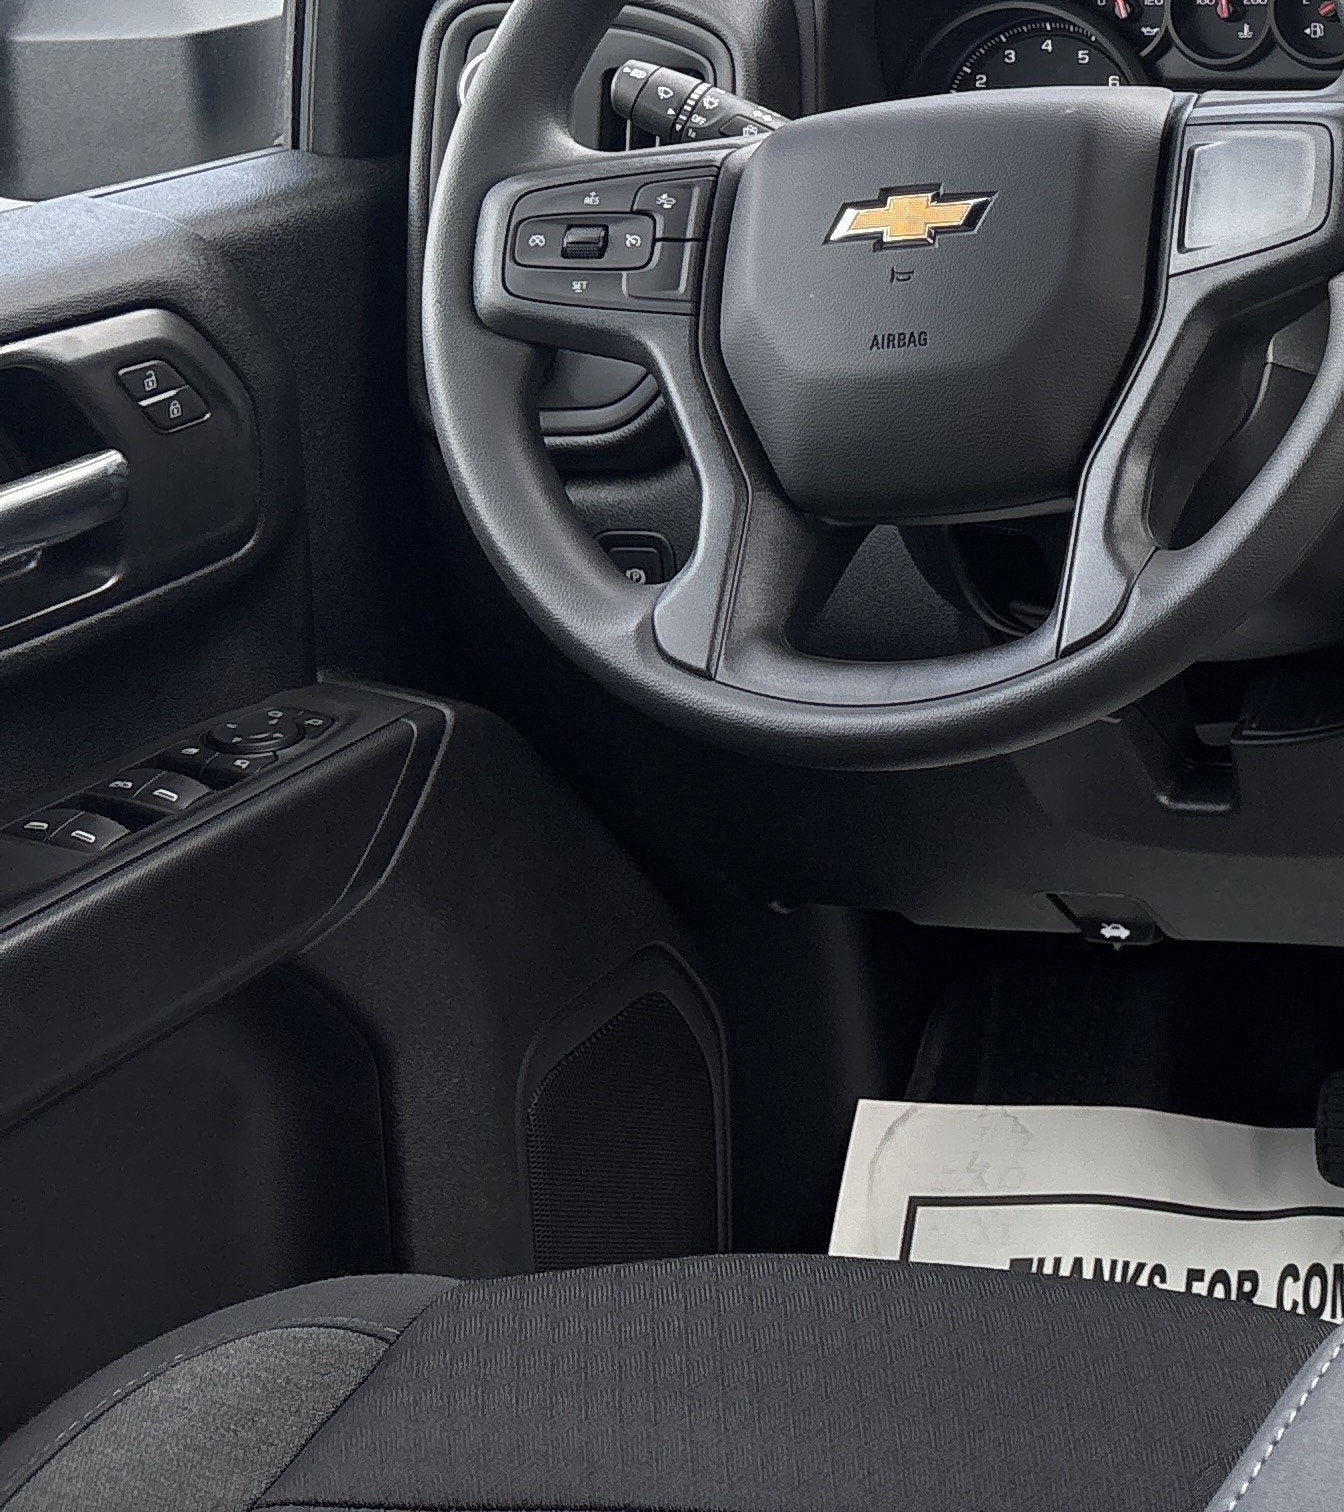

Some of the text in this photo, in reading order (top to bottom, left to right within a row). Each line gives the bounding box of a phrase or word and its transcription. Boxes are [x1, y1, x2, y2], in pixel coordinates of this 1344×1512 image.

[1041, 39, 1053, 53] 4
[1004, 50, 1016, 64] 3
[1077, 50, 1090, 65] 5
[975, 75, 987, 88] 2
[869, 331, 928, 351] AIRBAG
